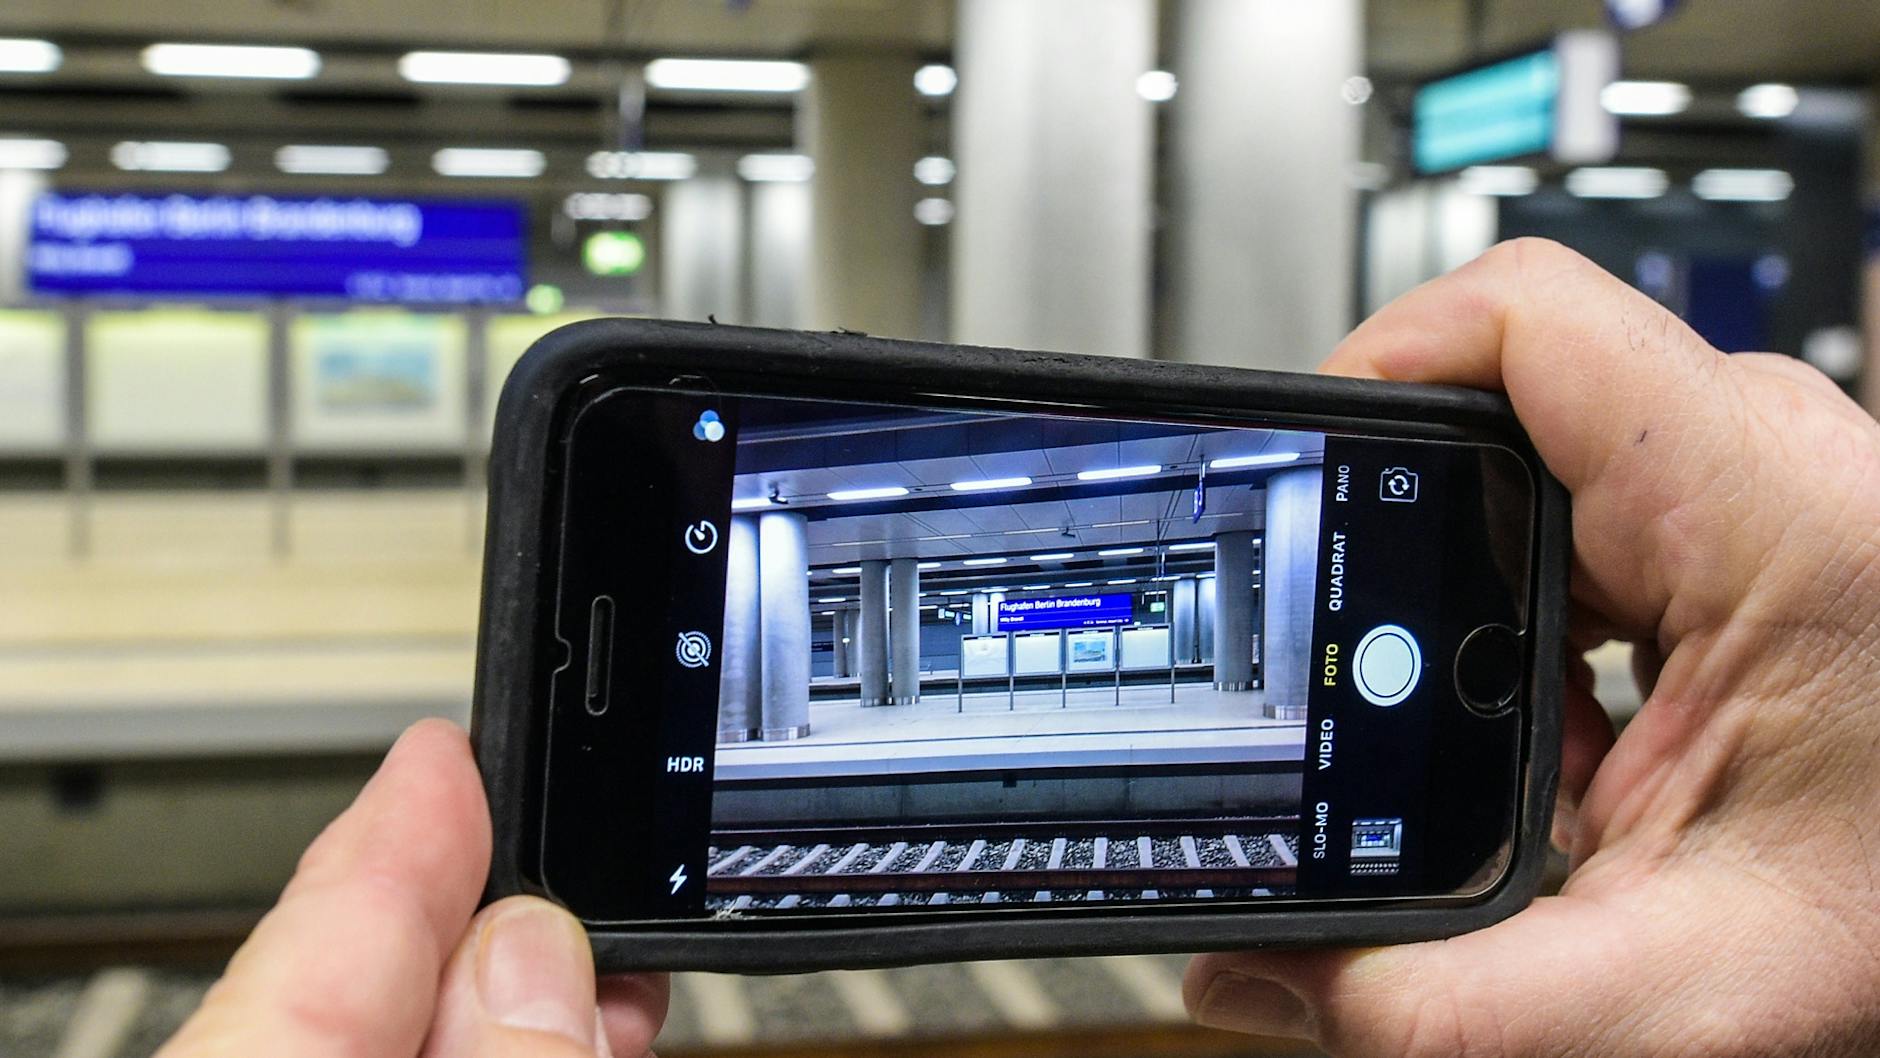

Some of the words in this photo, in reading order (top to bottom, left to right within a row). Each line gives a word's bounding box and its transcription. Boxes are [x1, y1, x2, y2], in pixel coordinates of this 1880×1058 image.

[1335, 464, 1350, 502] PANO
[1328, 531, 1346, 612] QUADRAT
[1000, 602, 1034, 612] Flughafen
[1034, 600, 1056, 609] Berlin
[1056, 598, 1101, 608] Brandenburg
[1323, 643, 1339, 687] FOTO
[666, 756, 705, 773] HDR
[1318, 718, 1335, 771] VIDEO
[1312, 801, 1329, 859] SLO-MO
